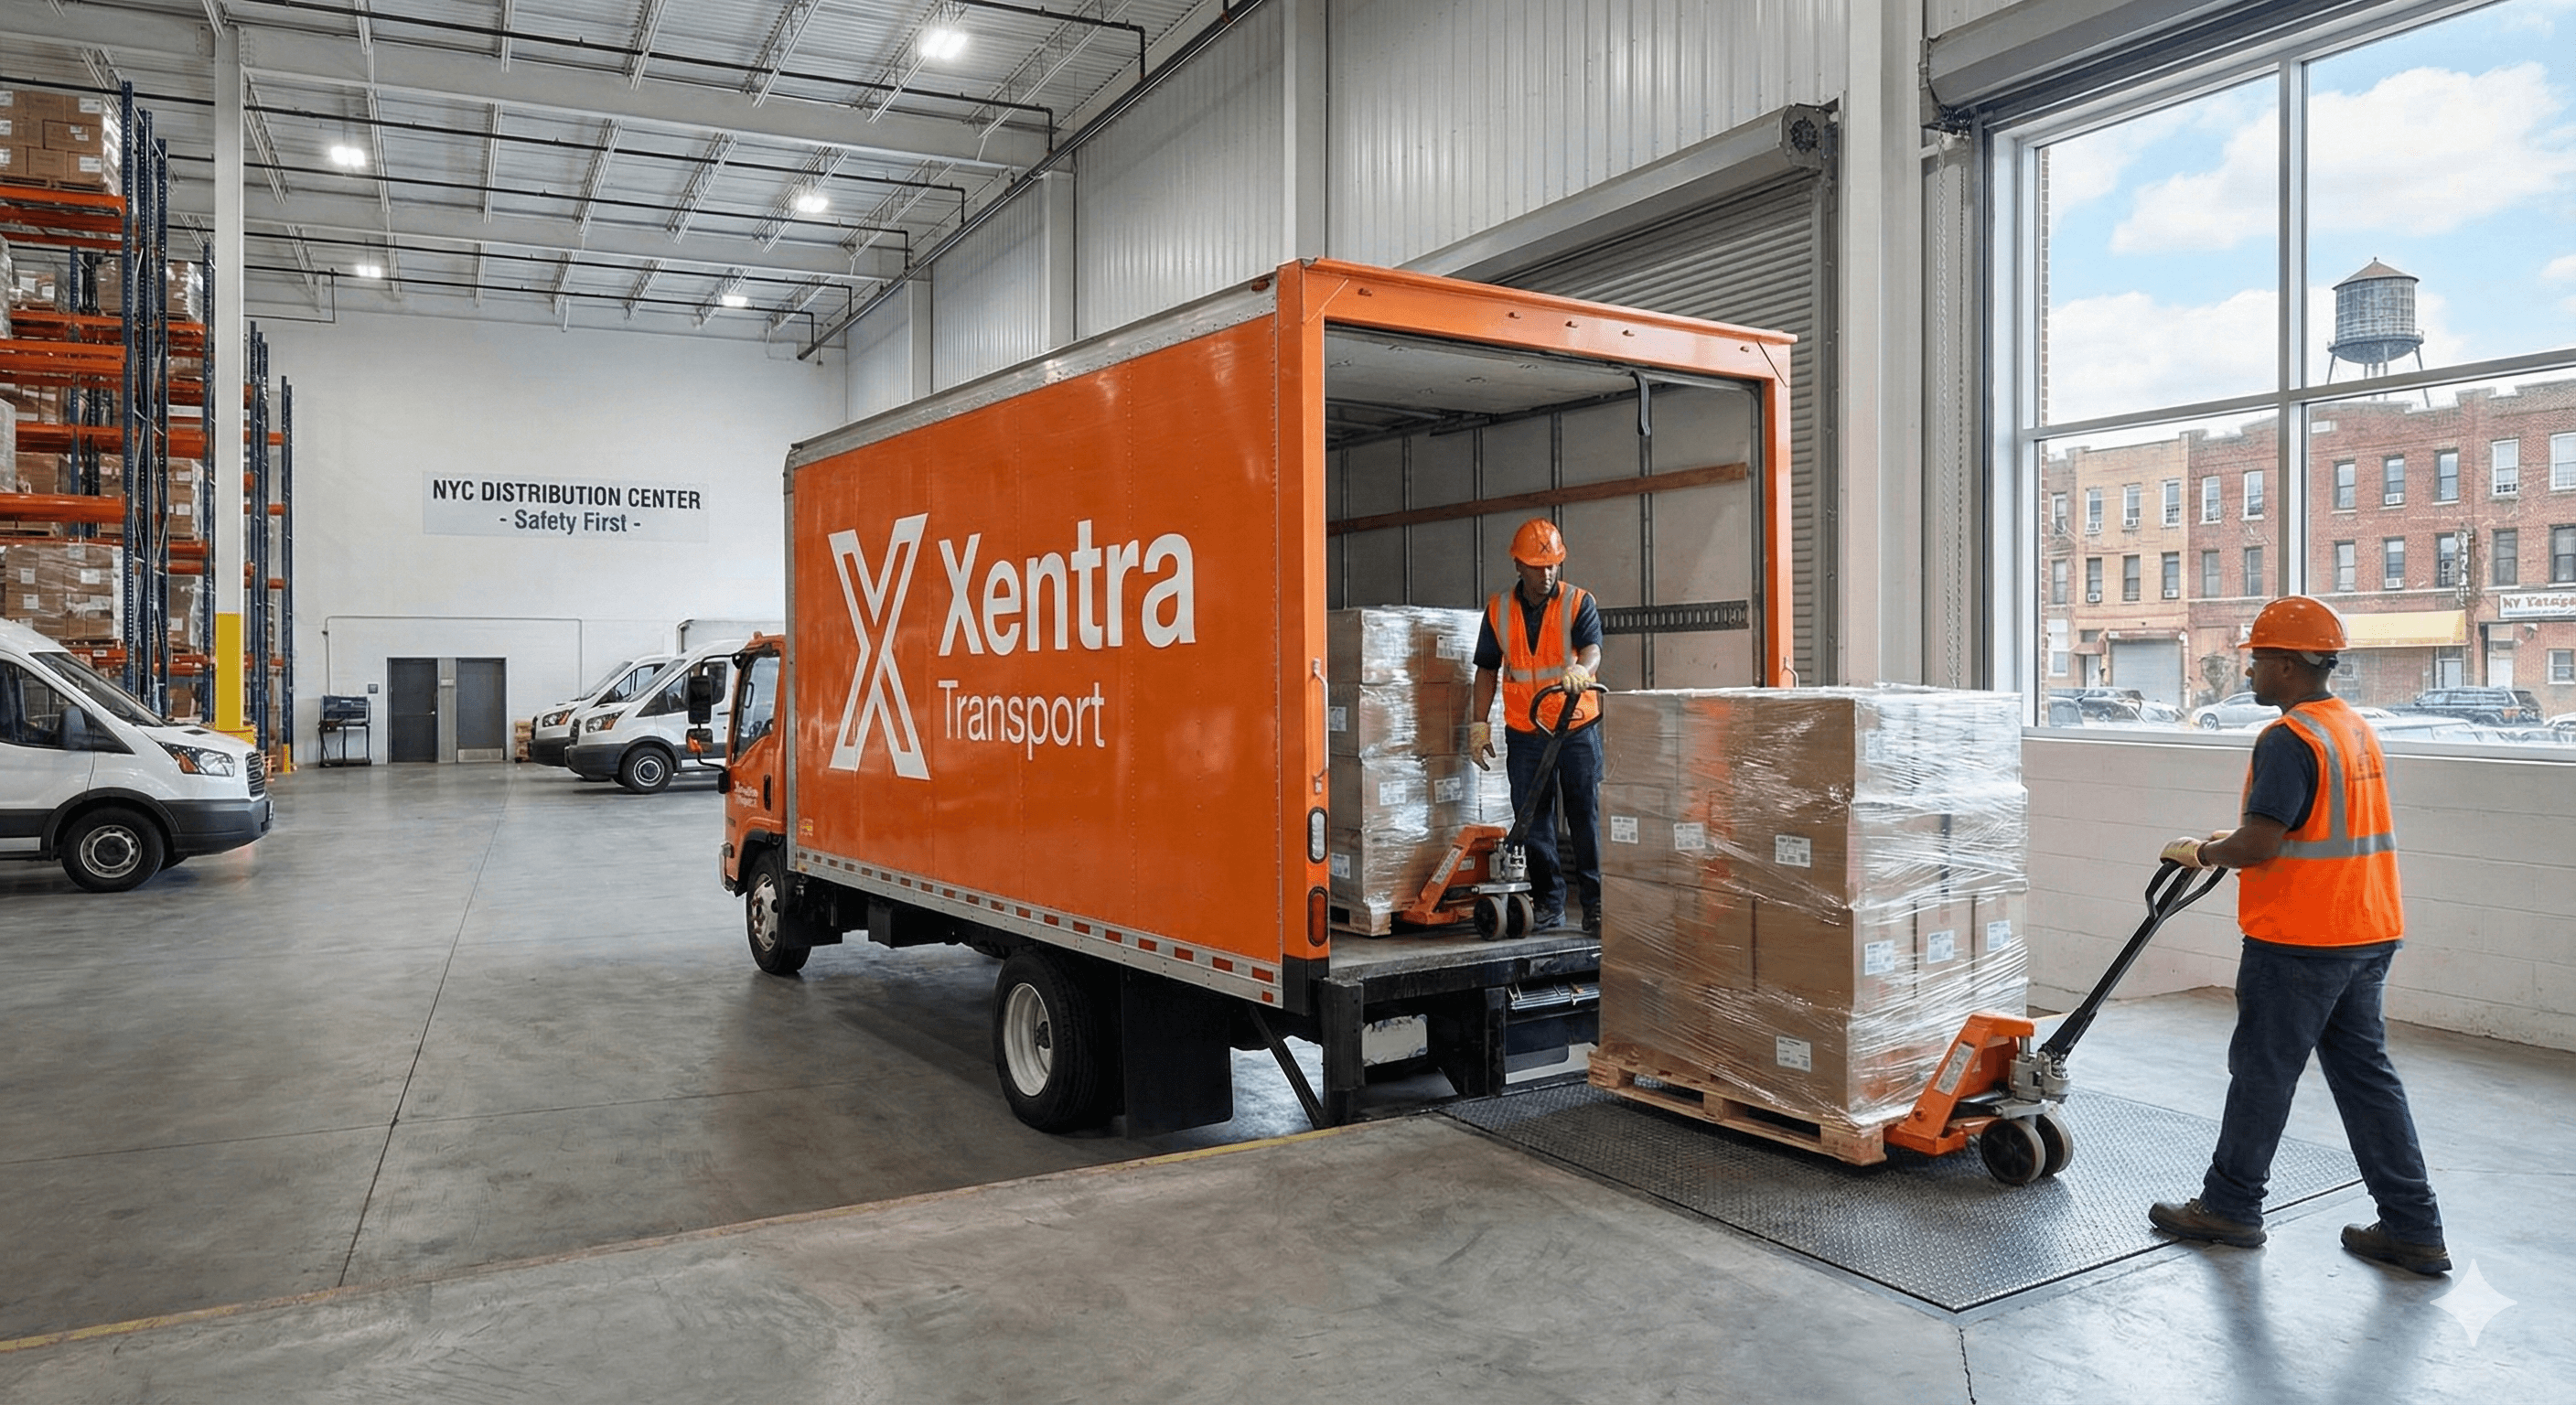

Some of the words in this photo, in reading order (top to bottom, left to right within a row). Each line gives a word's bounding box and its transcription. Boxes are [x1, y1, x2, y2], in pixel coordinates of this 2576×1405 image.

[433, 479, 475, 501] NYC
[481, 481, 621, 507] DISTRIBUTION
[628, 488, 701, 510] CENTER
[514, 509, 577, 536] Safety
[584, 511, 628, 532] First
[938, 519, 1197, 657] Xentra
[938, 680, 1105, 761] Transport
